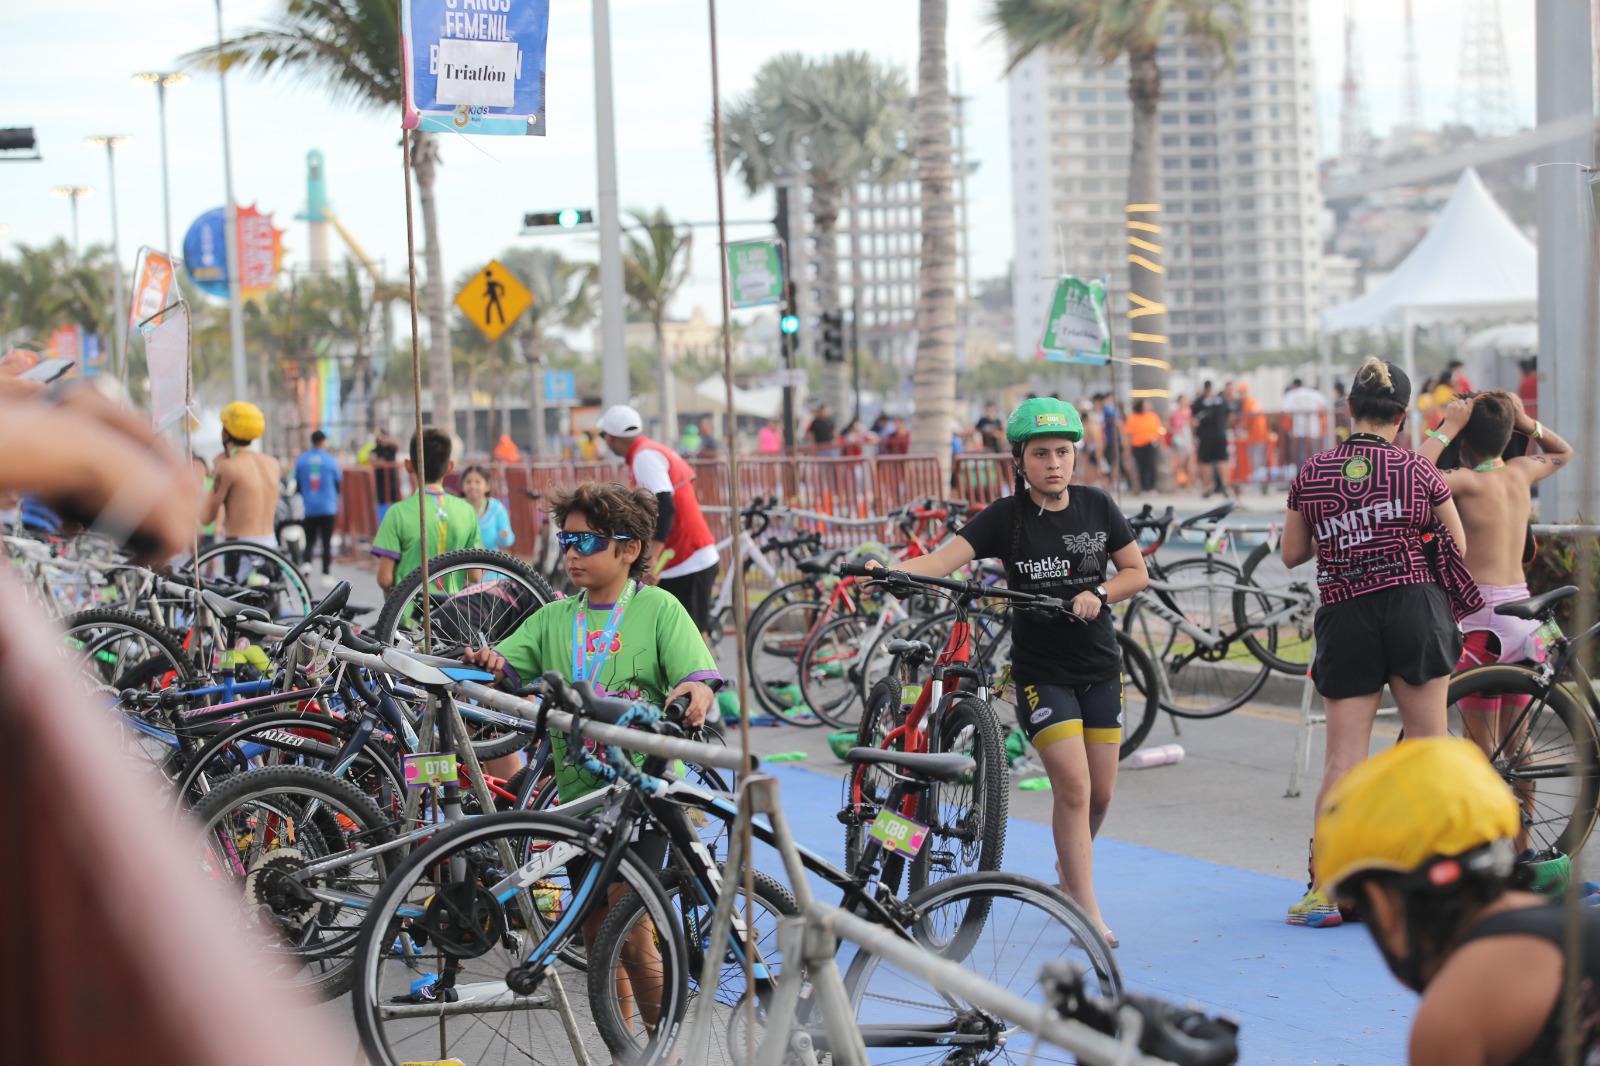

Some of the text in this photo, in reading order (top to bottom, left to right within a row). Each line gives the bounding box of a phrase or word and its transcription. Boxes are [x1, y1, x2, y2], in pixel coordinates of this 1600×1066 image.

[445, 11, 510, 41] FEMENIL
[444, 63, 506, 82] Triatlón
[425, 760, 449, 775] 078
